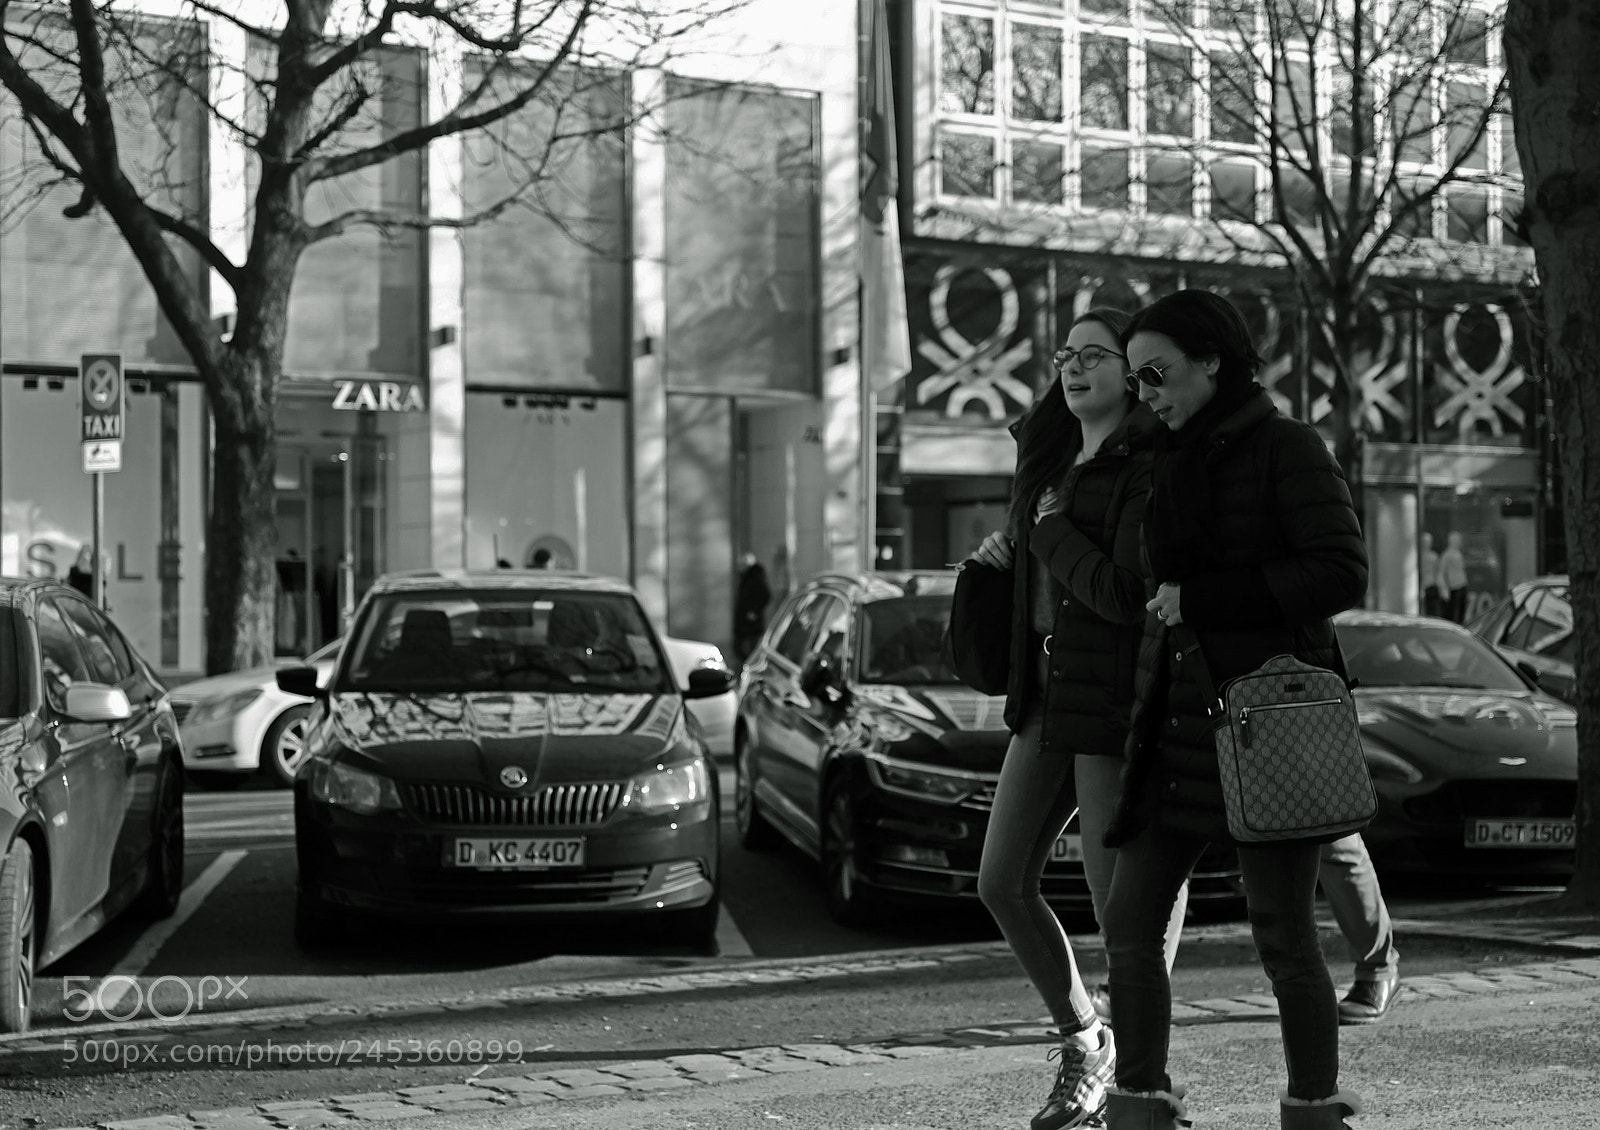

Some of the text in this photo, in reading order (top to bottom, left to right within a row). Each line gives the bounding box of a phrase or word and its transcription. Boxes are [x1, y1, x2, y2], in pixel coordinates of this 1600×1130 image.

[331, 380, 425, 411] ZARA
[84, 414, 119, 437] TAXI
[28, 542, 182, 582] SLE
[1530, 824, 1574, 842] 1509
[459, 841, 472, 863] D
[524, 841, 580, 863] 4407
